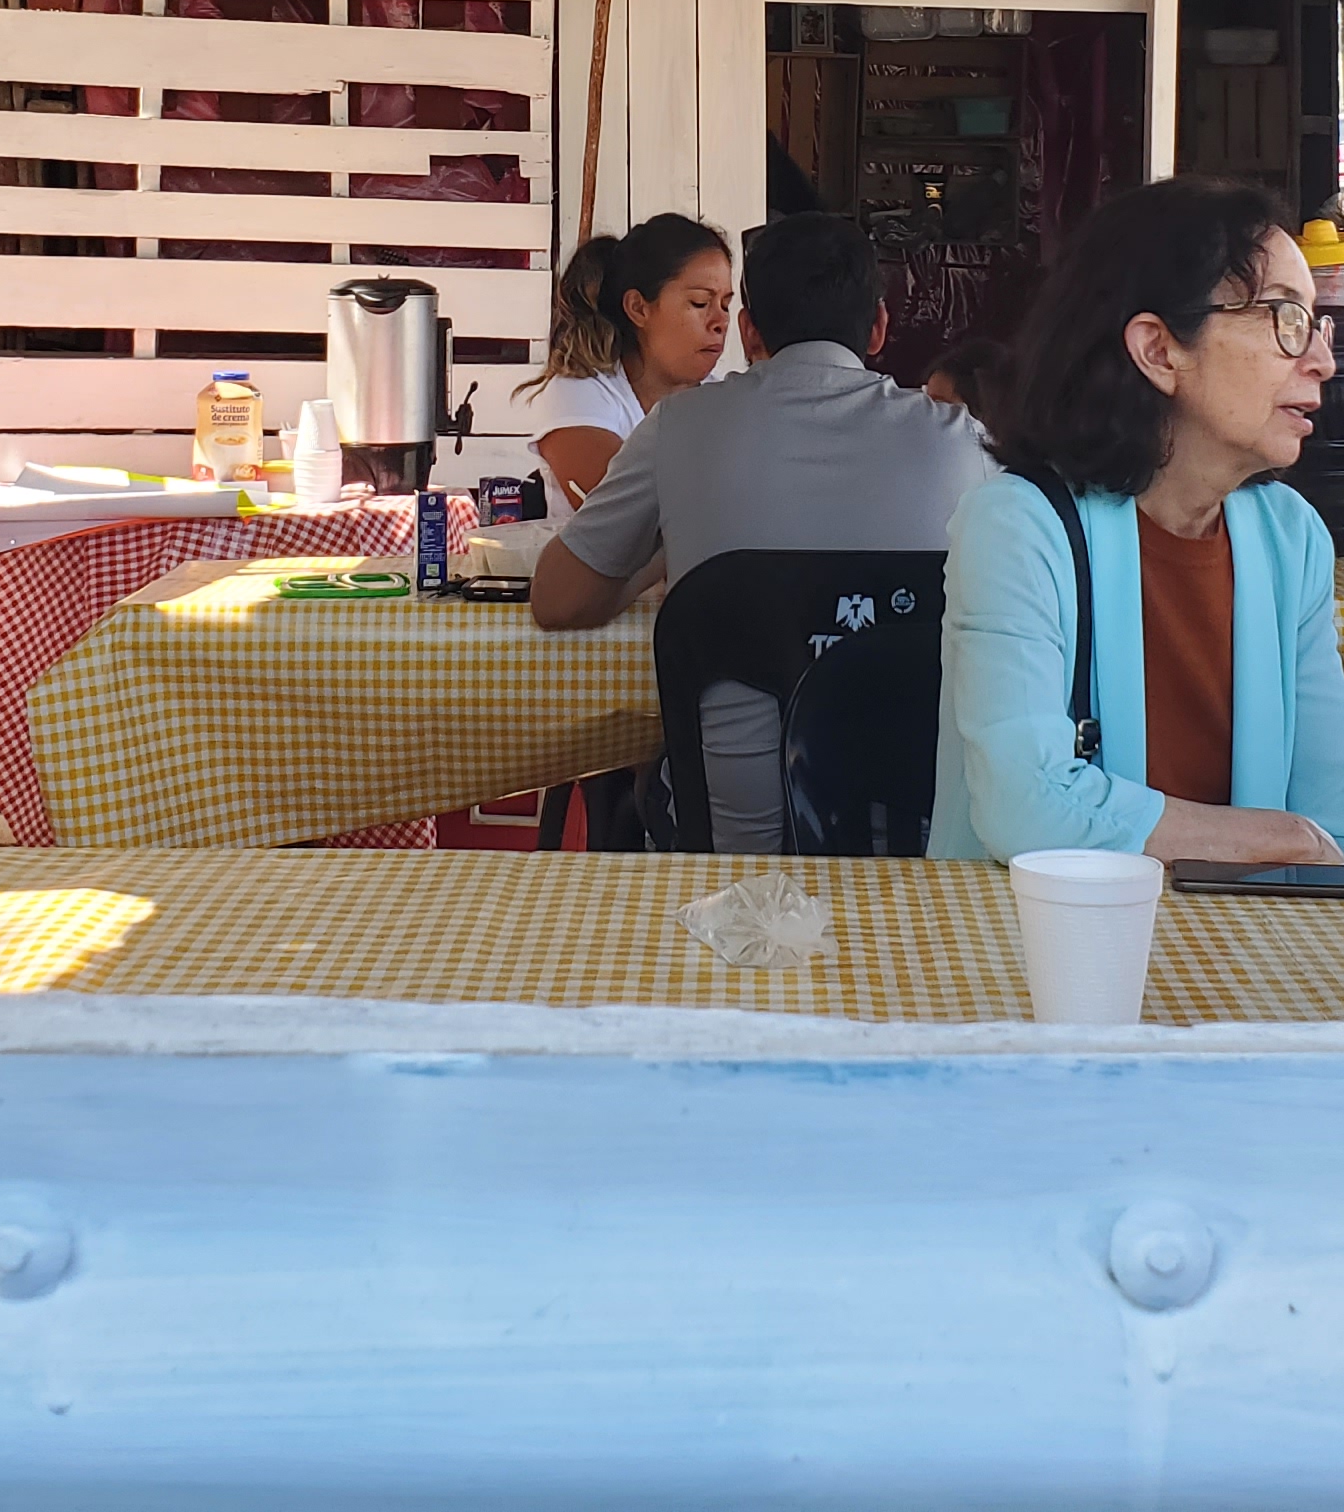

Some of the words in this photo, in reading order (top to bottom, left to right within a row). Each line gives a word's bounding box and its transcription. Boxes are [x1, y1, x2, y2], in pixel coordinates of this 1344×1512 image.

[210, 404, 251, 414] Sustituto
[211, 412, 222, 422] de
[222, 414, 250, 422] crema
[492, 484, 521, 496] JUMEX
